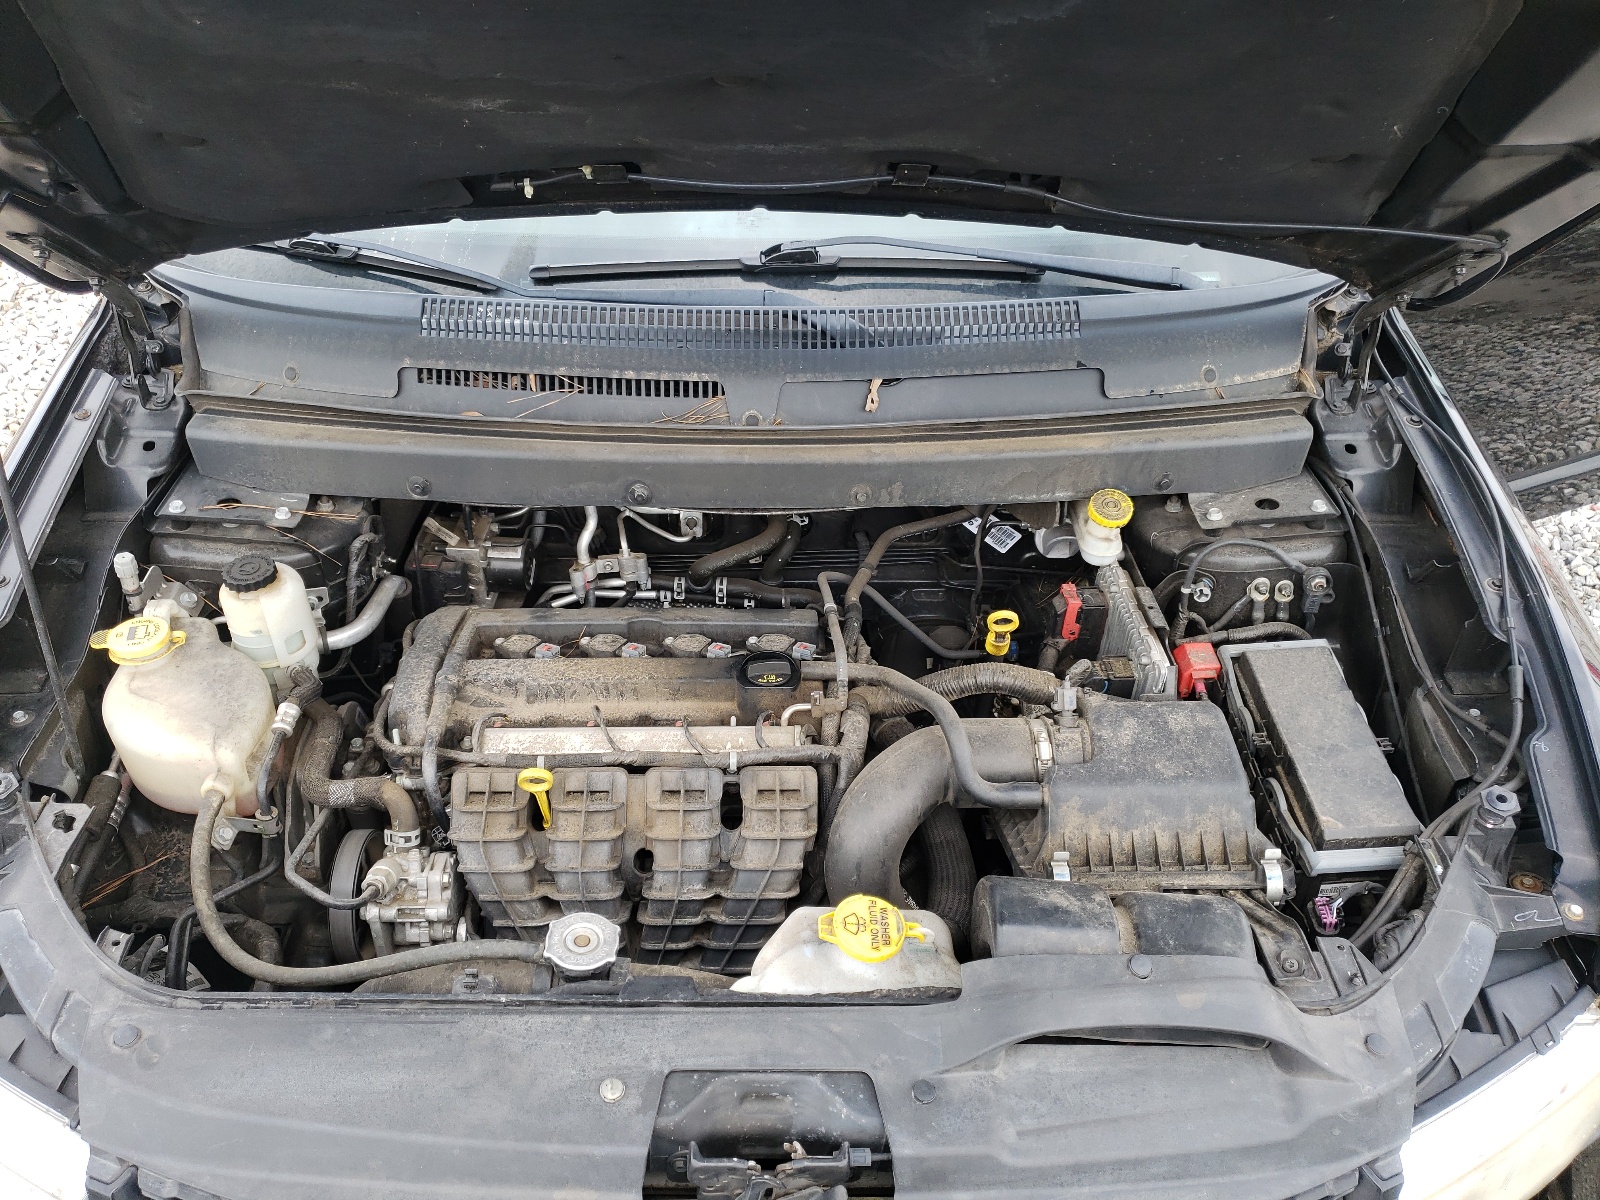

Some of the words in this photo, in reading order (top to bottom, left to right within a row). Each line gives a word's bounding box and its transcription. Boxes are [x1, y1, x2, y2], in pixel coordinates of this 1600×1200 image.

[868, 899, 878, 925] FLUID
[870, 928, 881, 952] ONLY
[880, 907, 891, 947] WASHER
